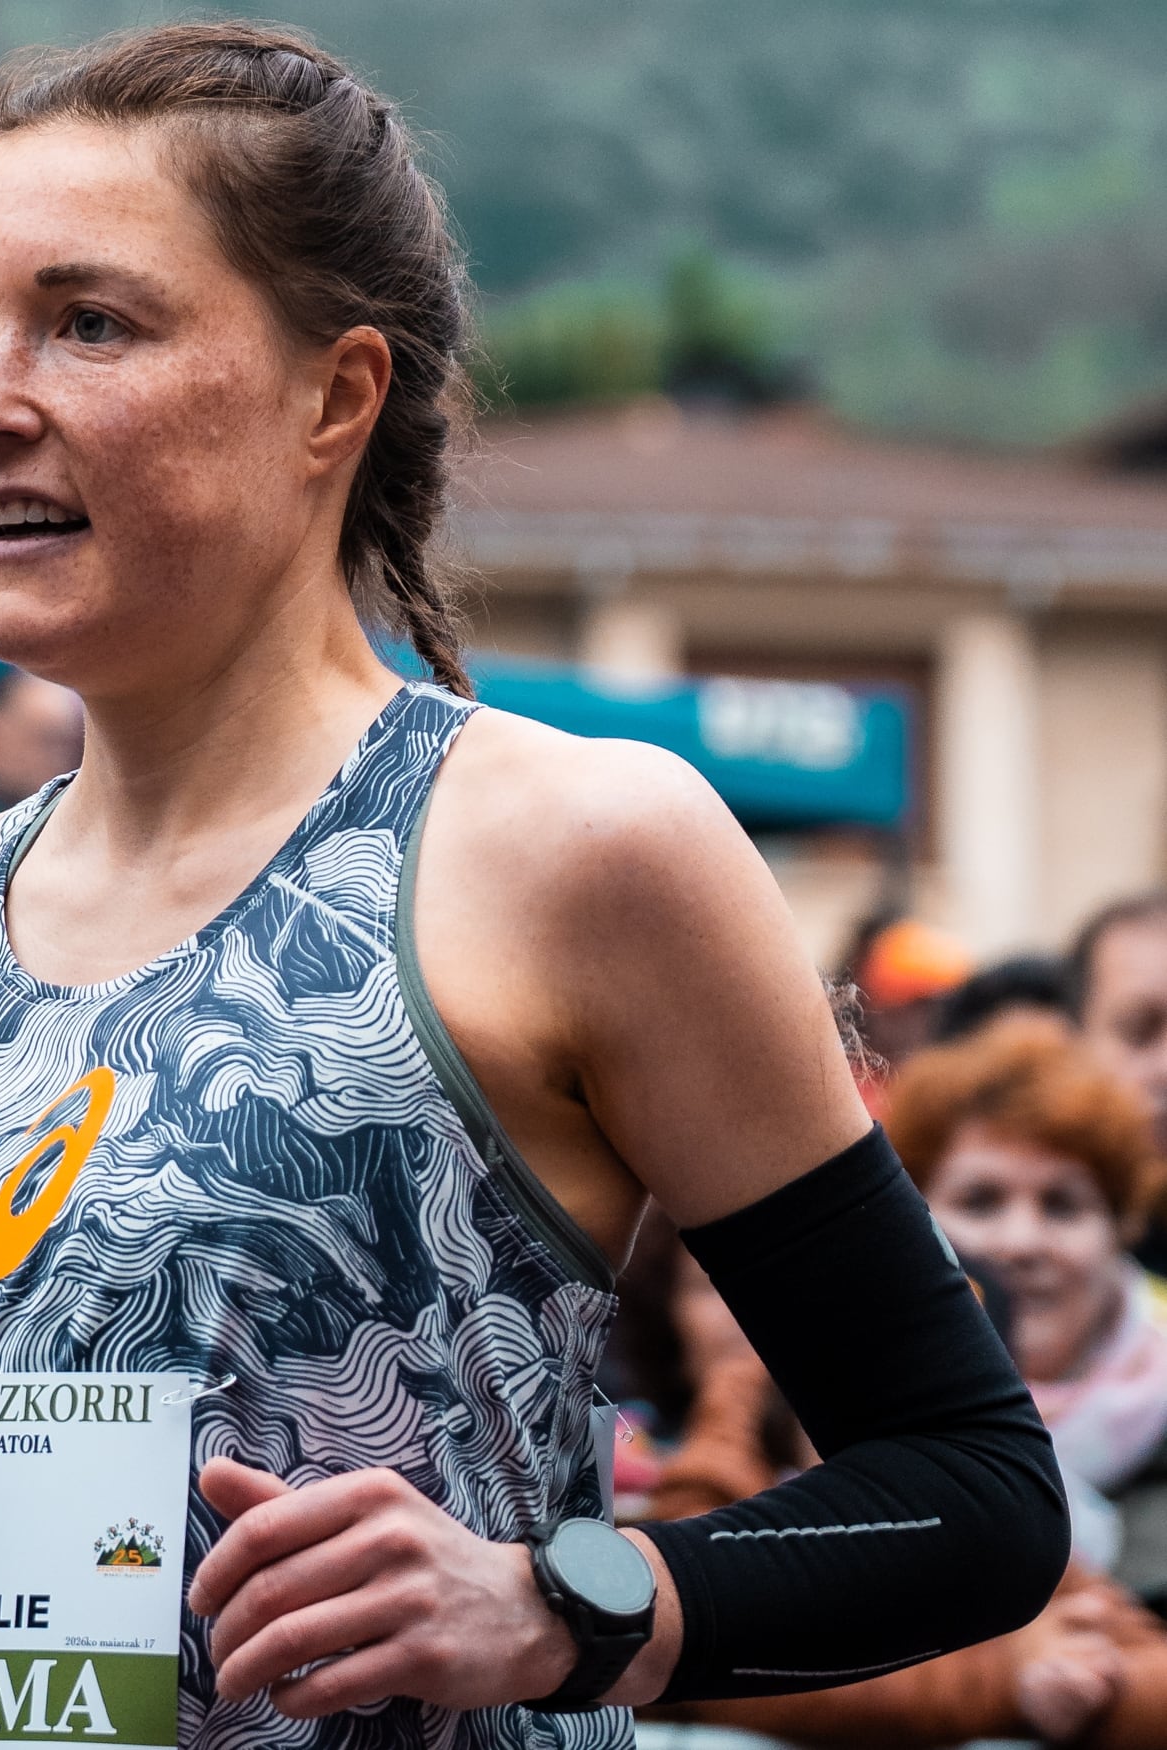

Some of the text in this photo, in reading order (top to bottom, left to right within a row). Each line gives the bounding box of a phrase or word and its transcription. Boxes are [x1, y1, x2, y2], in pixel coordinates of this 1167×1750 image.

[113, 1550, 142, 1566] 25
[65, 1636, 154, 1648] 2026ko maiatzak 17
